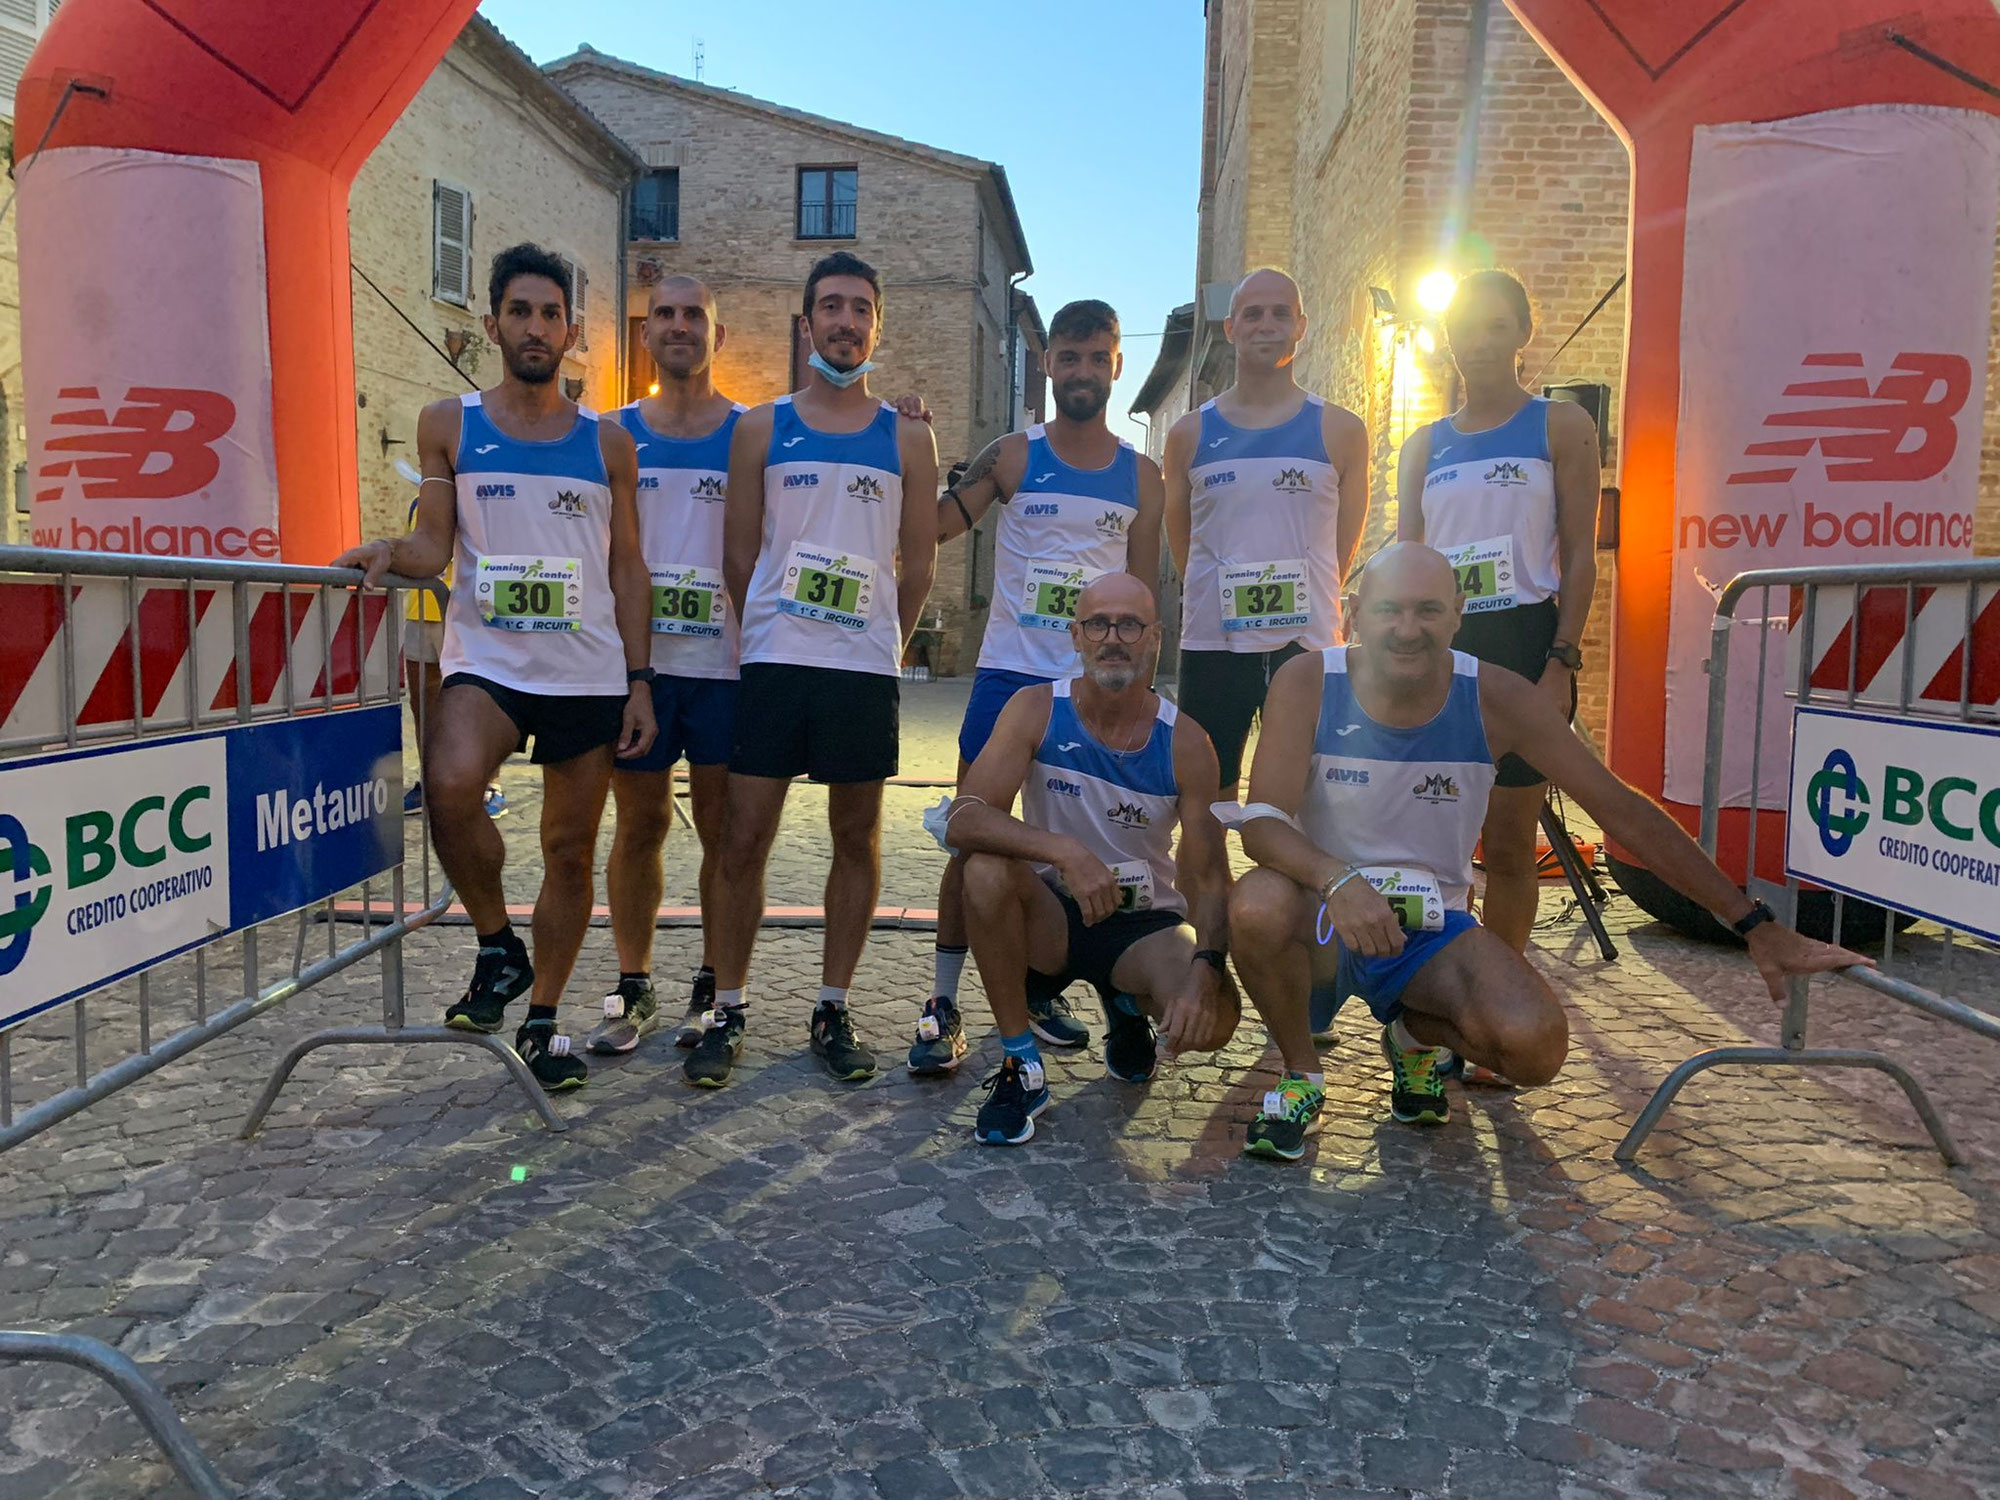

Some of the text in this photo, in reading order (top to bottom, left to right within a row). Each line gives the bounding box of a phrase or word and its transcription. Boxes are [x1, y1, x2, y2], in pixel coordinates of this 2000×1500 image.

[637, 477, 659, 488] VIS
[783, 473, 819, 488] AVIS
[1204, 471, 1236, 488] AVIS
[1427, 469, 1458, 488] AVIS
[476, 484, 516, 498] AVIS
[1024, 503, 1059, 516] AVIS
[1679, 502, 1973, 550] new balance
[32, 516, 280, 558] ew balance
[1471, 550, 1503, 561] center
[484, 563, 527, 574] running
[539, 571, 573, 580] center
[796, 551, 832, 565] running
[841, 567, 869, 580] center
[1033, 568, 1069, 579] running
[649, 571, 721, 590] nning center
[1225, 570, 1301, 581] running center
[507, 582, 551, 615] 30
[807, 572, 845, 608] 31
[1246, 584, 1283, 614] 32
[661, 587, 700, 619] 36
[1467, 598, 1512, 612] IRCUITO
[823, 612, 865, 628] IRCUITO
[1269, 616, 1308, 626] IRCUITO
[681, 625, 720, 636] IRCUITO
[1326, 767, 1369, 784] AVIS
[1046, 777, 1081, 796] AVIS
[256, 777, 389, 852] Metauro
[66, 785, 212, 890] BCC
[1879, 836, 1929, 867] CREDITO
[1396, 885, 1432, 893] center
[67, 865, 213, 936] CREDITO COOPERATIVO
[1387, 897, 1408, 928] 5
